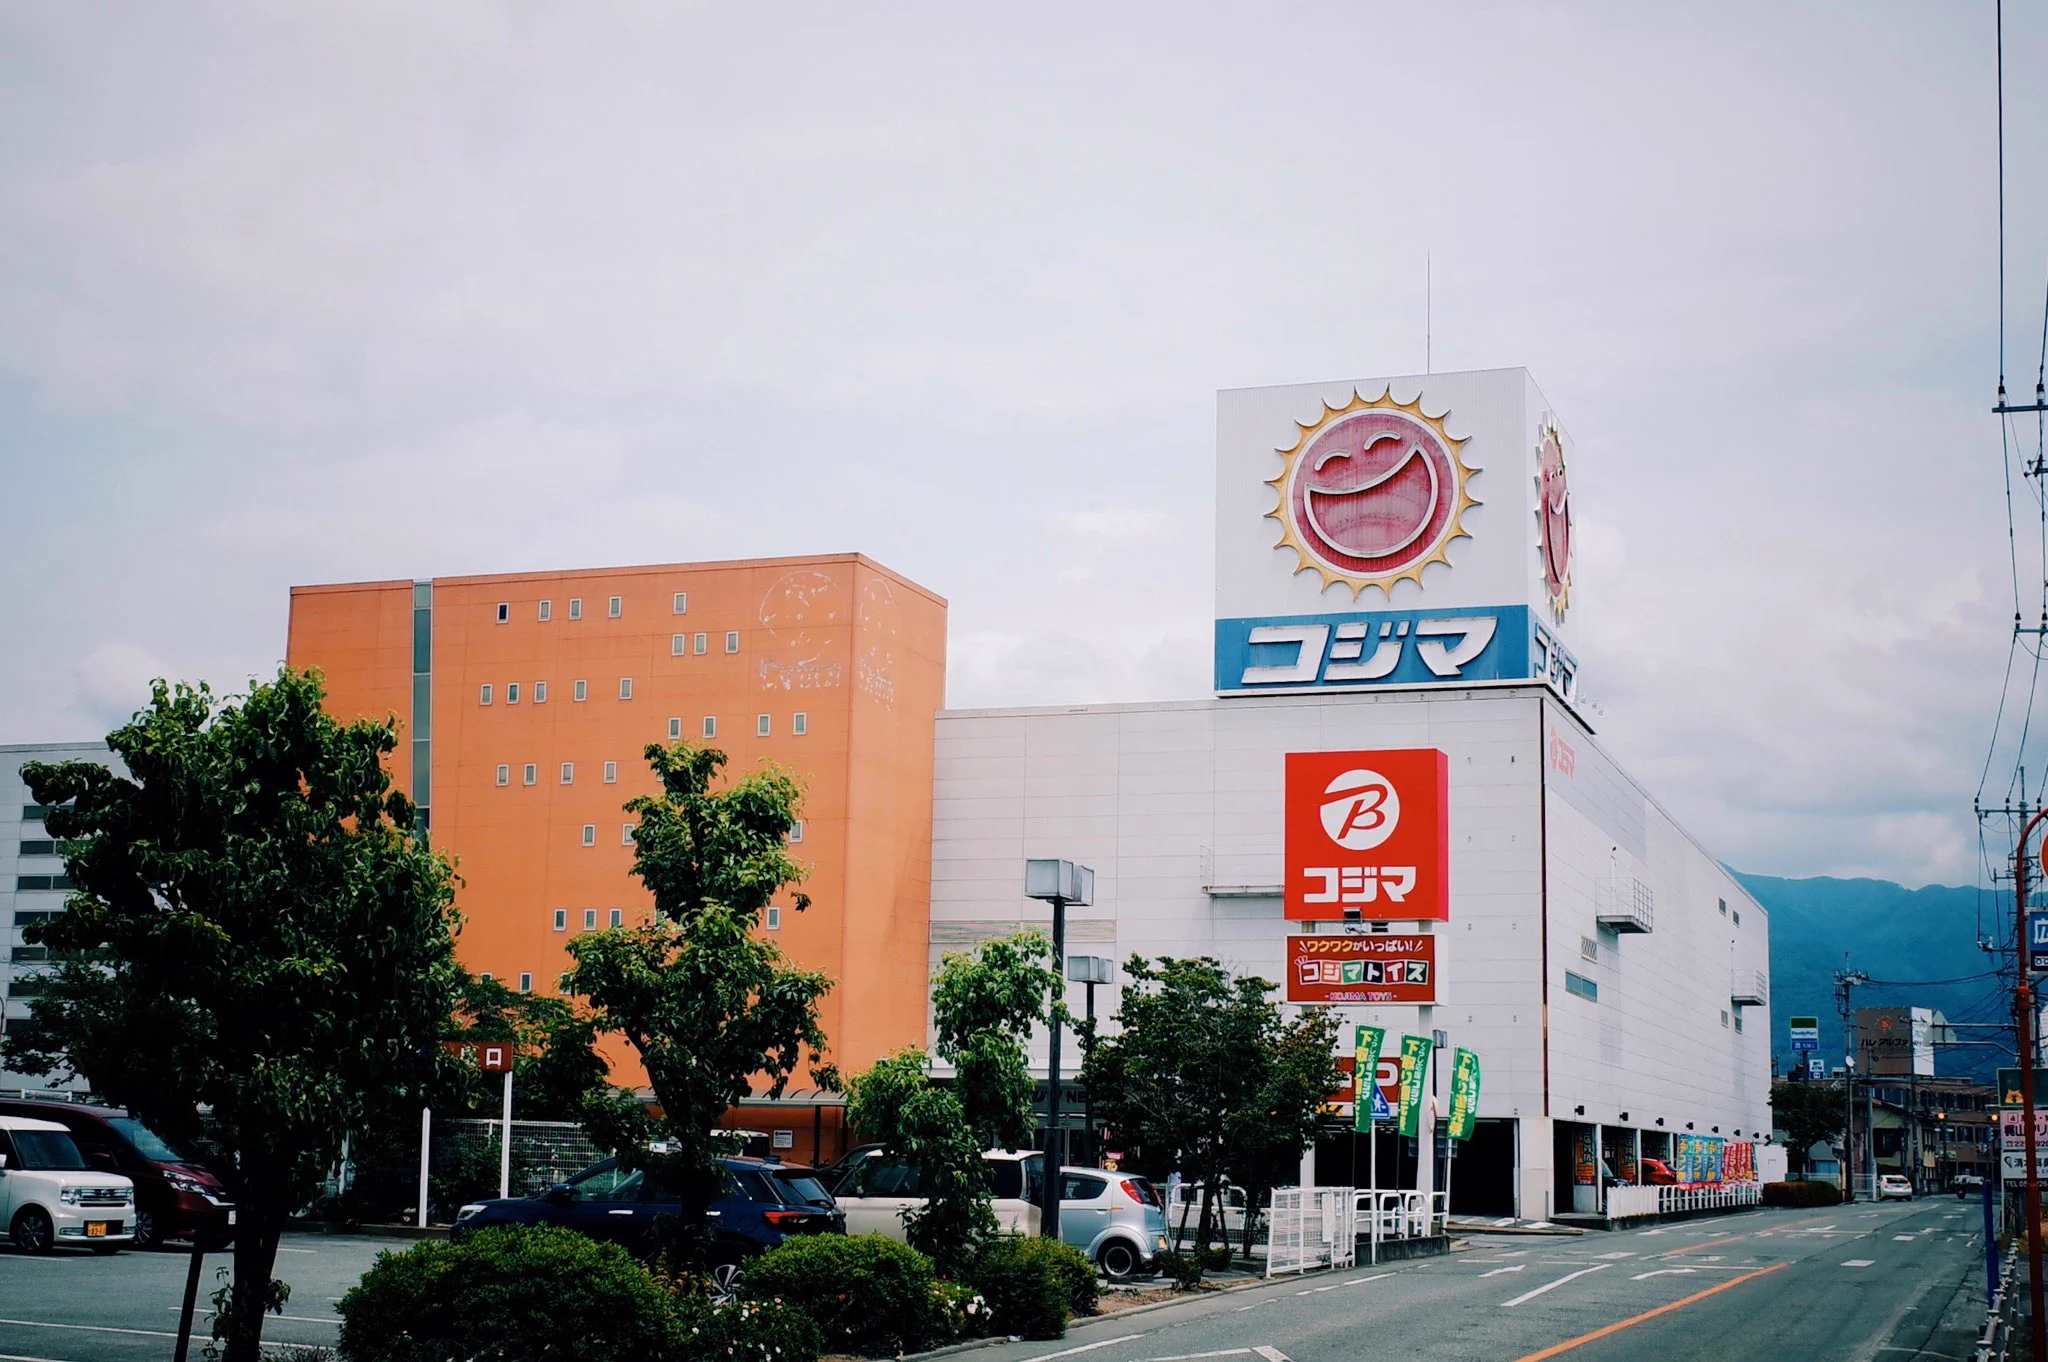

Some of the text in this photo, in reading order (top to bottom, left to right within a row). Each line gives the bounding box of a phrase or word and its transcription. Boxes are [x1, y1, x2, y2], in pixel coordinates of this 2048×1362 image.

[1241, 616, 1499, 684] コジマ
[1534, 622, 1578, 703] コジマ
[1303, 866, 1416, 903] コジマ
[1302, 962, 1424, 981] コジマトイズ
[1329, 991, 1393, 1001] KOJIMA TOYS
